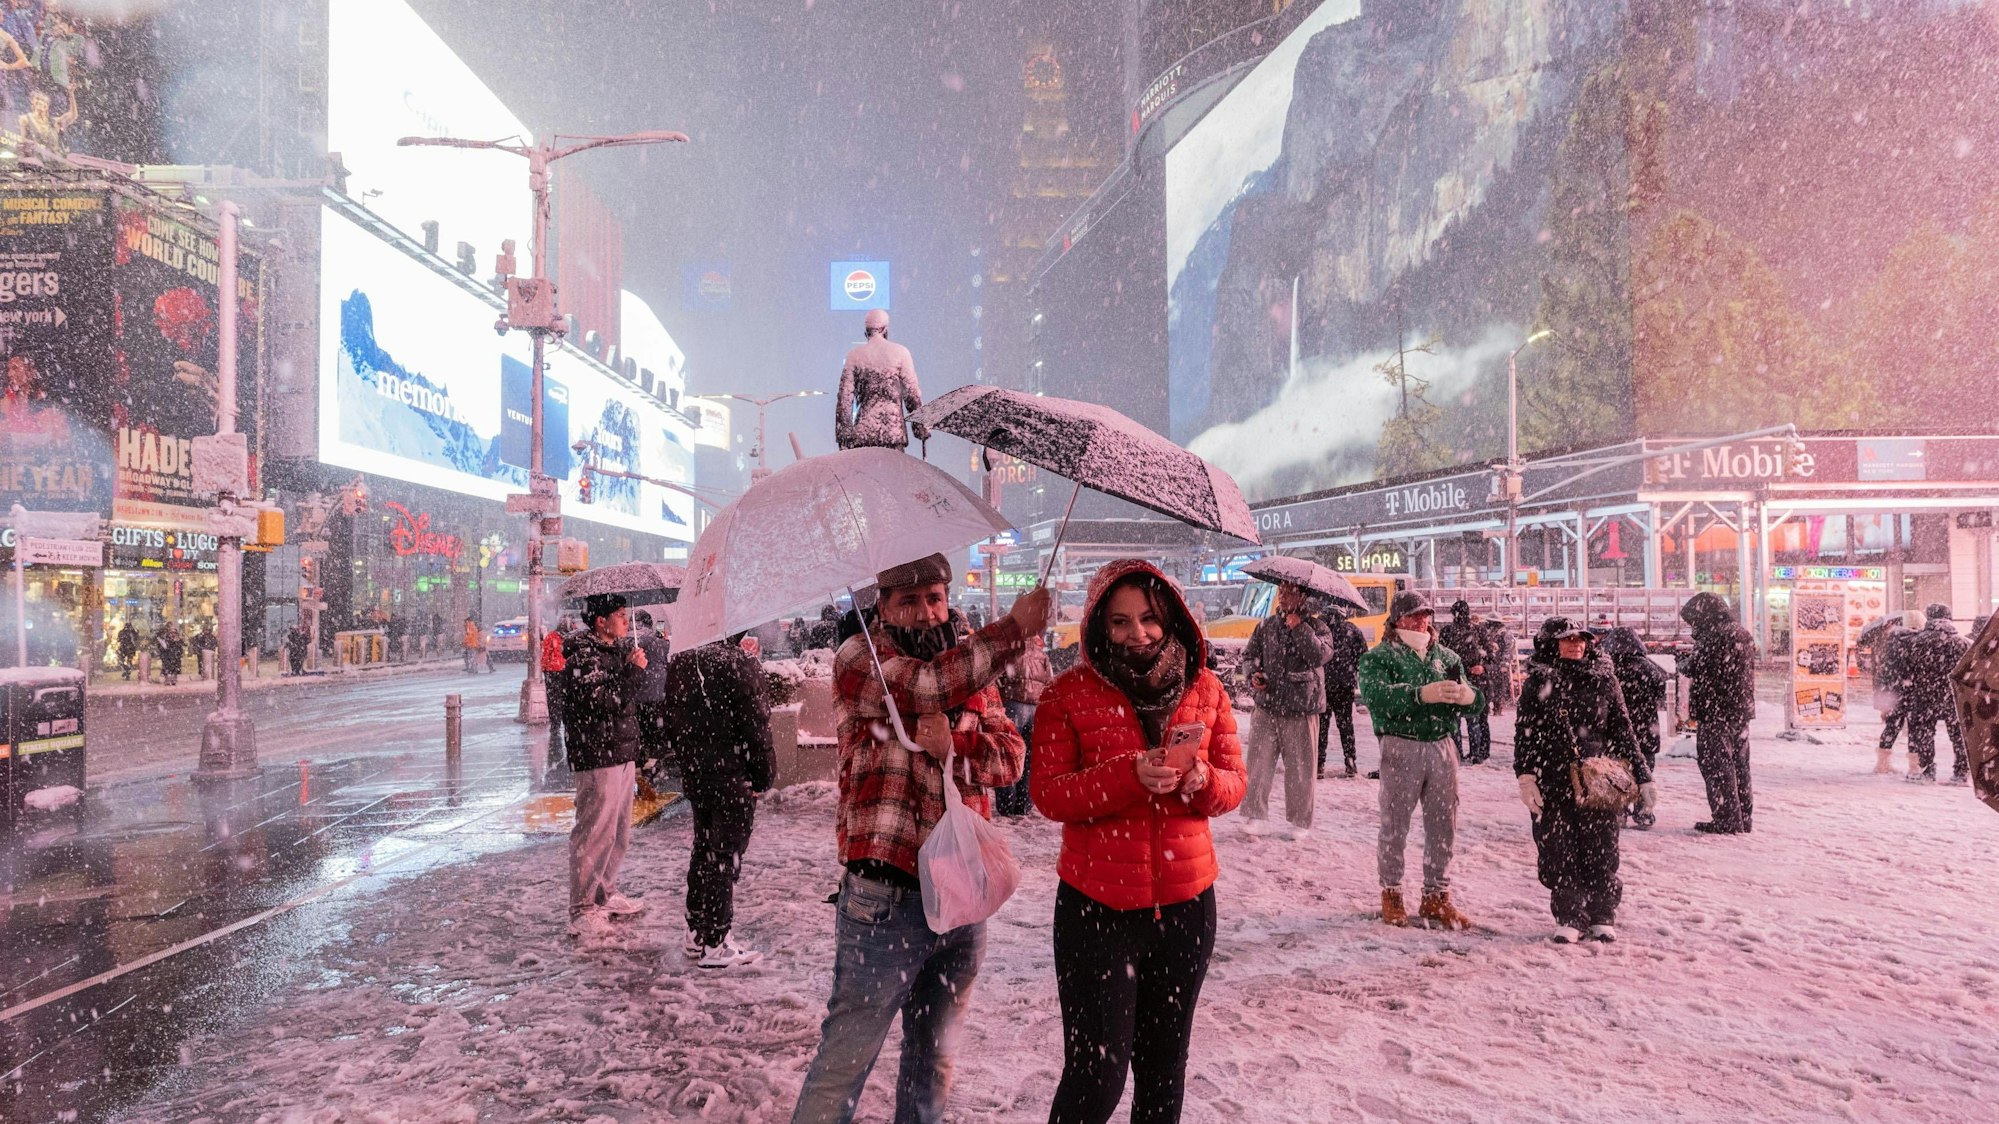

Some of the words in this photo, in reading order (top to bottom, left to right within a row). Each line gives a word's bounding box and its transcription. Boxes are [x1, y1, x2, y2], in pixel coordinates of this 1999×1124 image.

[1140, 65, 1182, 109] MARRIOTT
[1140, 84, 1177, 121] MARQUIS
[125, 224, 185, 270] WORLD
[178, 229, 197, 252] SEE
[119, 426, 191, 478] HADE
[1701, 445, 1816, 478] Mobie
[1403, 482, 1466, 514] Mobile
[112, 527, 165, 547] GIFTS
